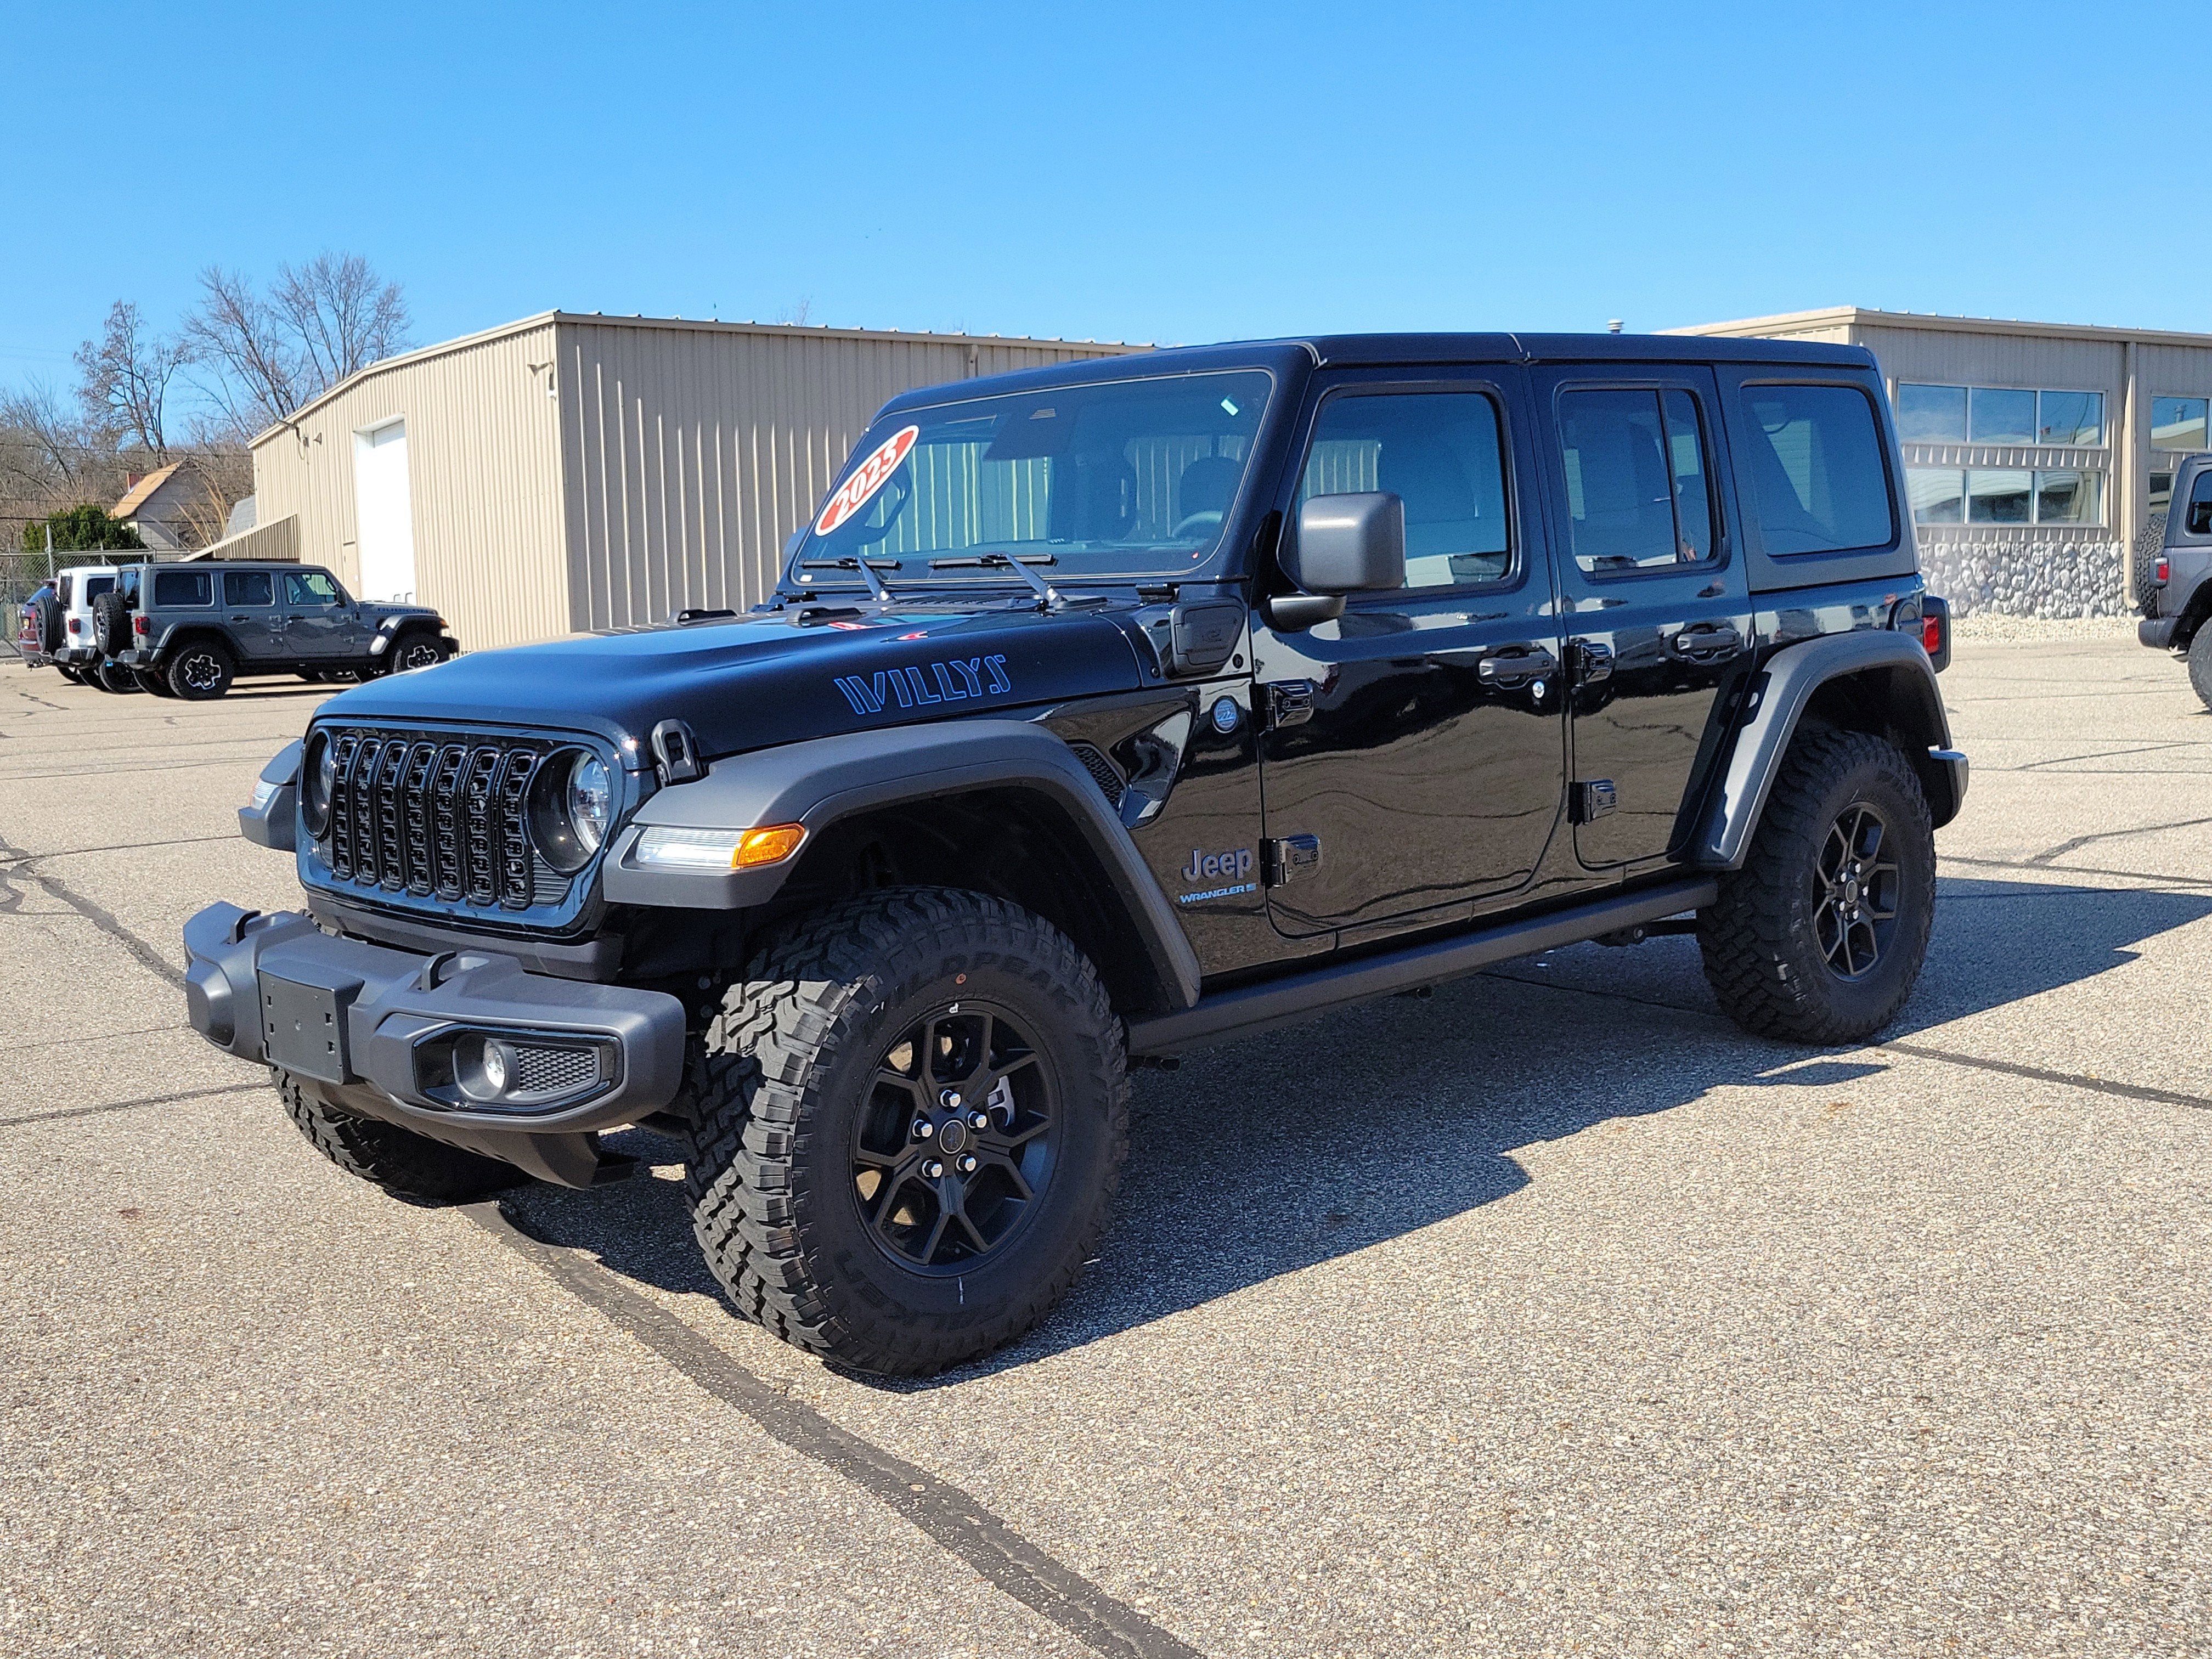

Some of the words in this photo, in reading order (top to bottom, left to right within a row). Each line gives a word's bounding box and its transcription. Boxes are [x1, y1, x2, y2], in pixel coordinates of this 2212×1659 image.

[833, 437, 899, 524] 2025
[834, 654, 1011, 714] WILLYS
[1181, 848, 1254, 882] Jeep
[1180, 885, 1245, 904] WRANGLER
